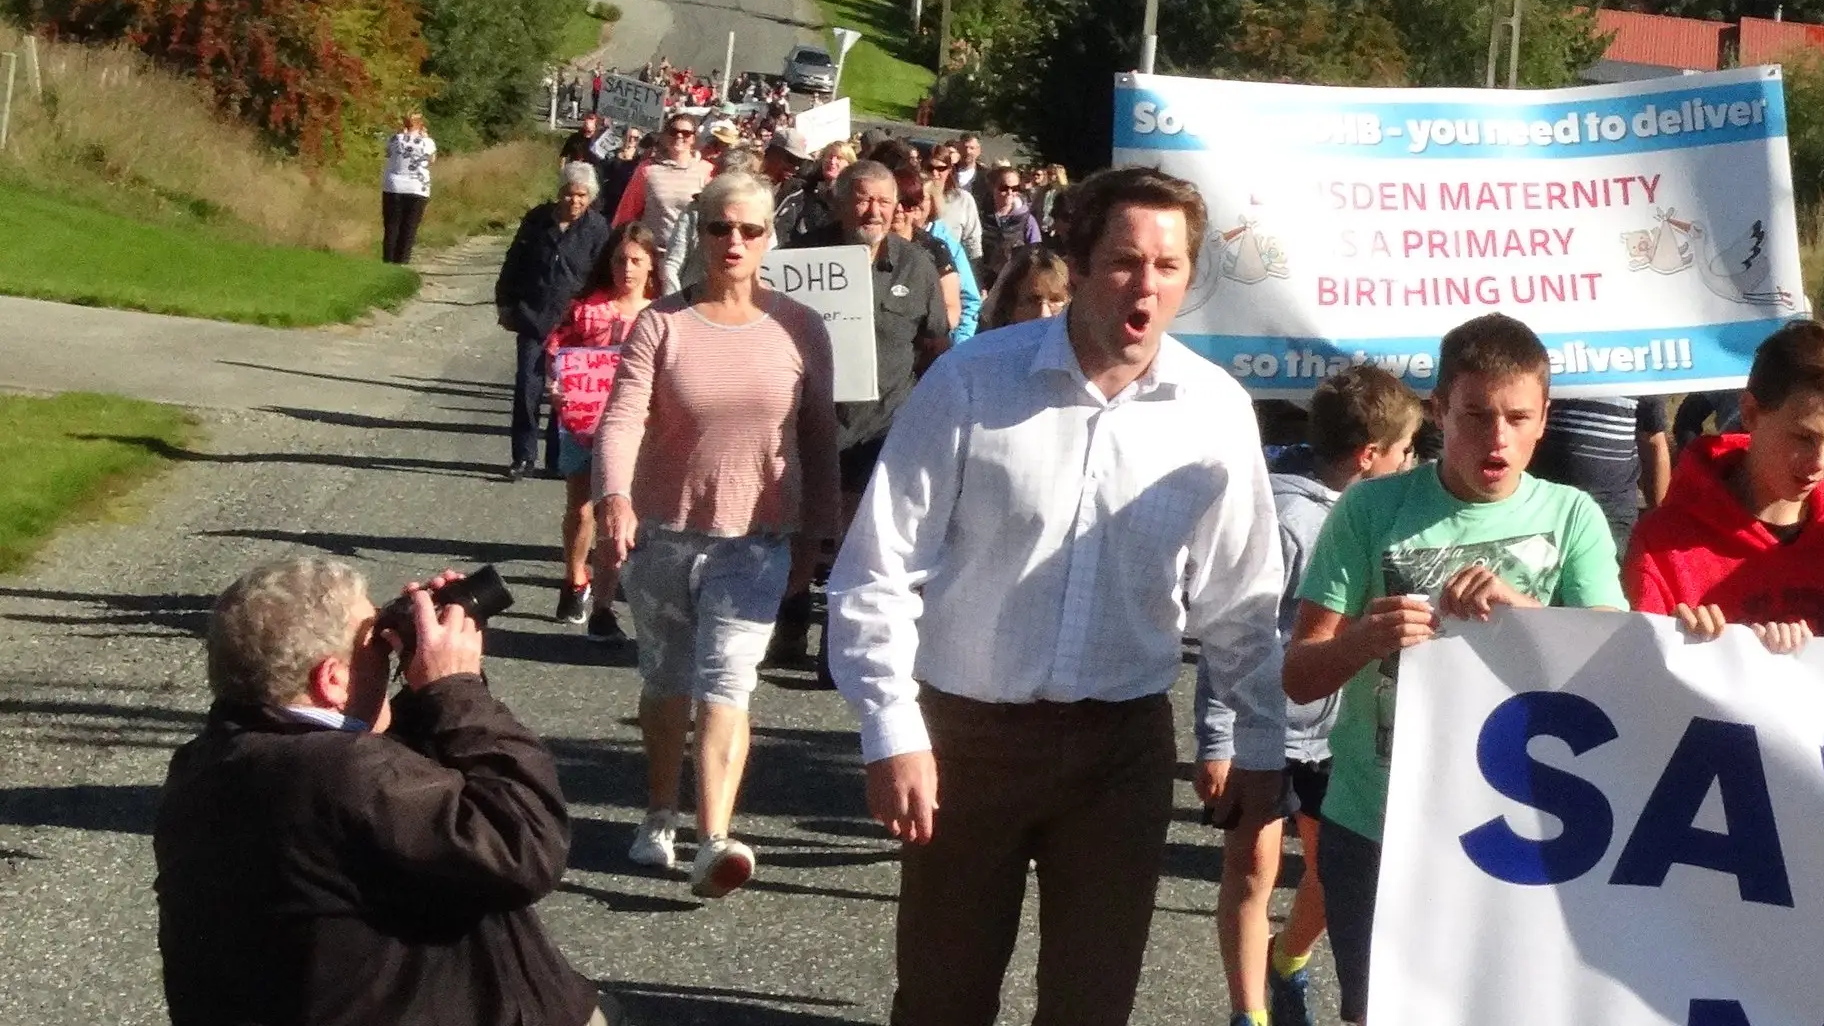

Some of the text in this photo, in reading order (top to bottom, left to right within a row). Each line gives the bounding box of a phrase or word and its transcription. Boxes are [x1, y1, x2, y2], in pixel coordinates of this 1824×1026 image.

[605, 76, 664, 106] SAFETY
[1406, 118, 1480, 154] you
[1482, 113, 1583, 147] need
[1585, 112, 1627, 142] to
[1631, 96, 1768, 139] deliver
[1439, 173, 1661, 212] MATERNITY
[1402, 227, 1576, 259] PRIMARY
[1317, 272, 1603, 307] BIRTHING UNIT
[1231, 350, 1280, 379] so
[1549, 337, 1694, 375] eliver!!!
